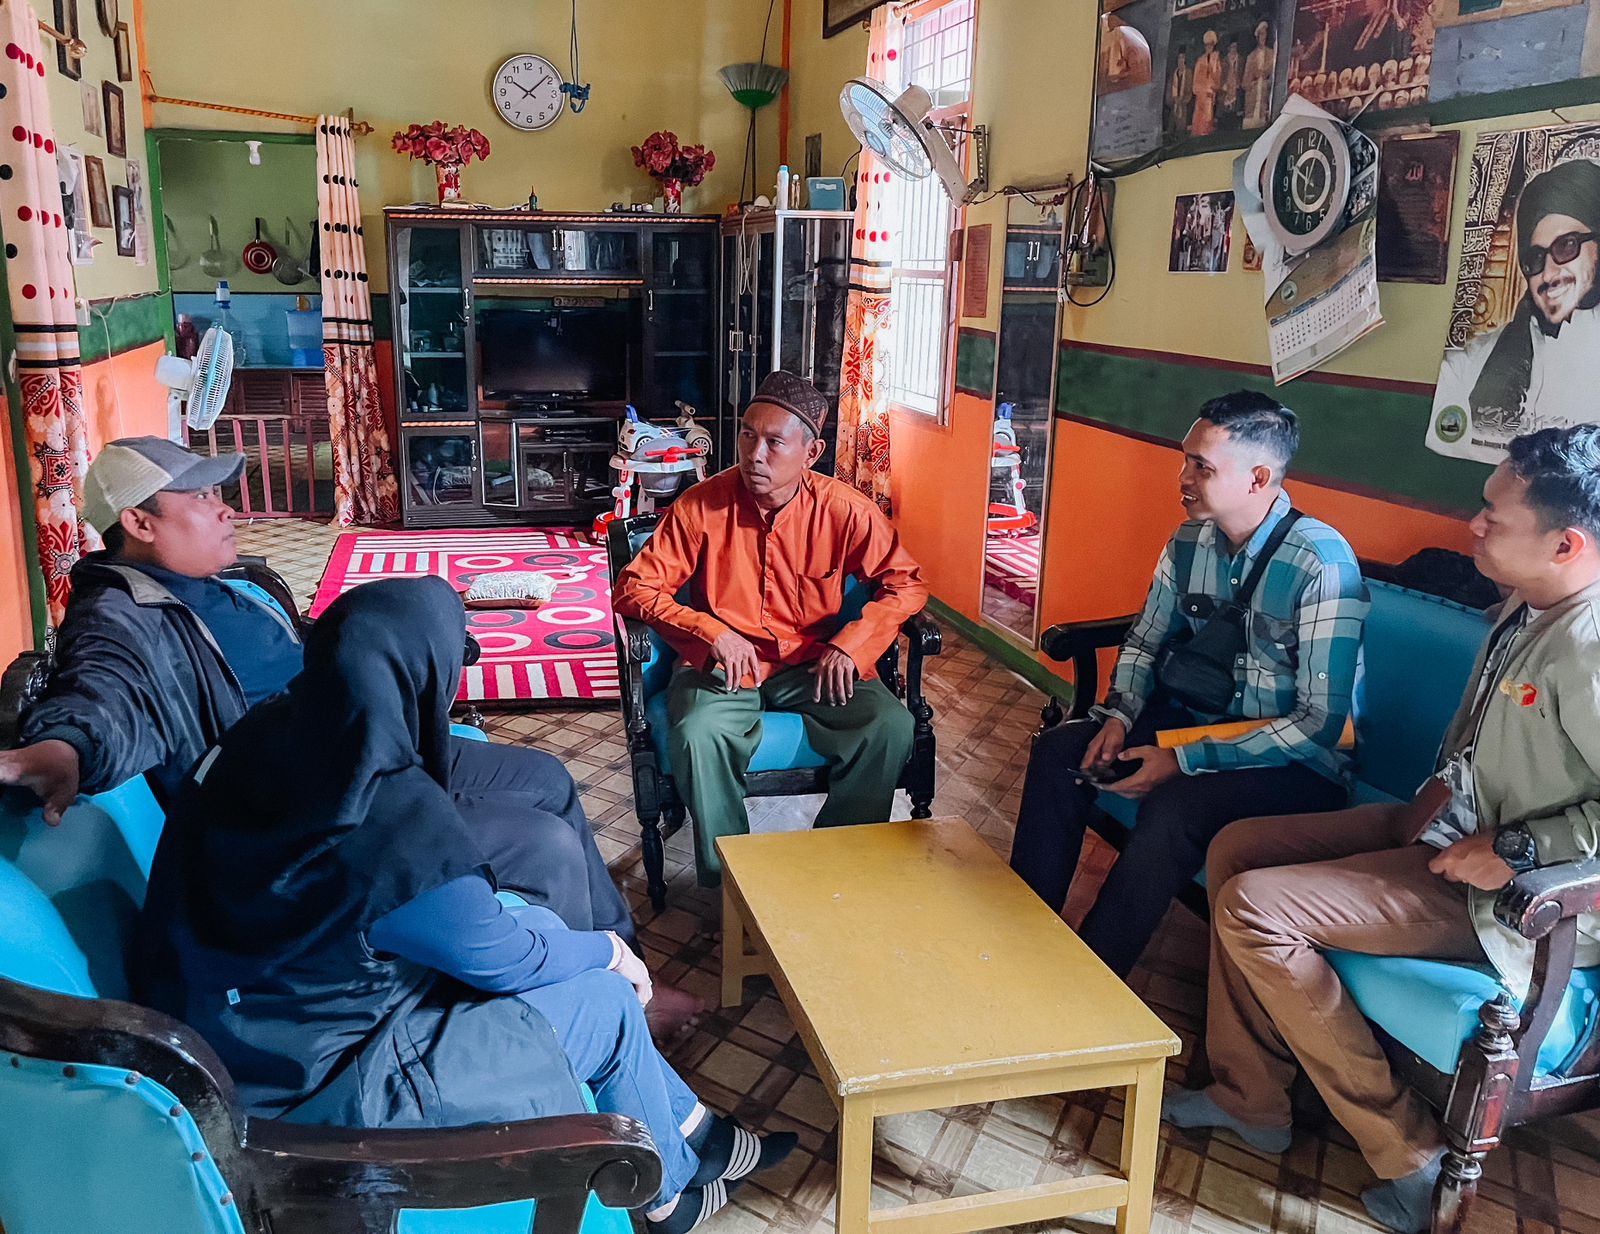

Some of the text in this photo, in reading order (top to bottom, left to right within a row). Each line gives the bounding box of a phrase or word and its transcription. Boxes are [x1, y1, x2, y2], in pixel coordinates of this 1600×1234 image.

[512, 66, 520, 74] 11
[523, 62, 533, 71] 12
[503, 75, 514, 84] 10
[547, 76, 553, 85] 2
[499, 88, 507, 97] 9
[550, 90, 557, 98] 3
[504, 101, 511, 110] 8
[547, 103, 554, 111] 4
[514, 111, 521, 119] 7
[526, 115, 533, 124] 6
[538, 112, 545, 120] 5
[1308, 130, 1317, 148] 12
[1297, 137, 1304, 154] 11
[1287, 154, 1295, 171] 10
[1283, 176, 1289, 192] 9
[1294, 210, 1300, 226] 7
[1305, 215, 1312, 231] 6
